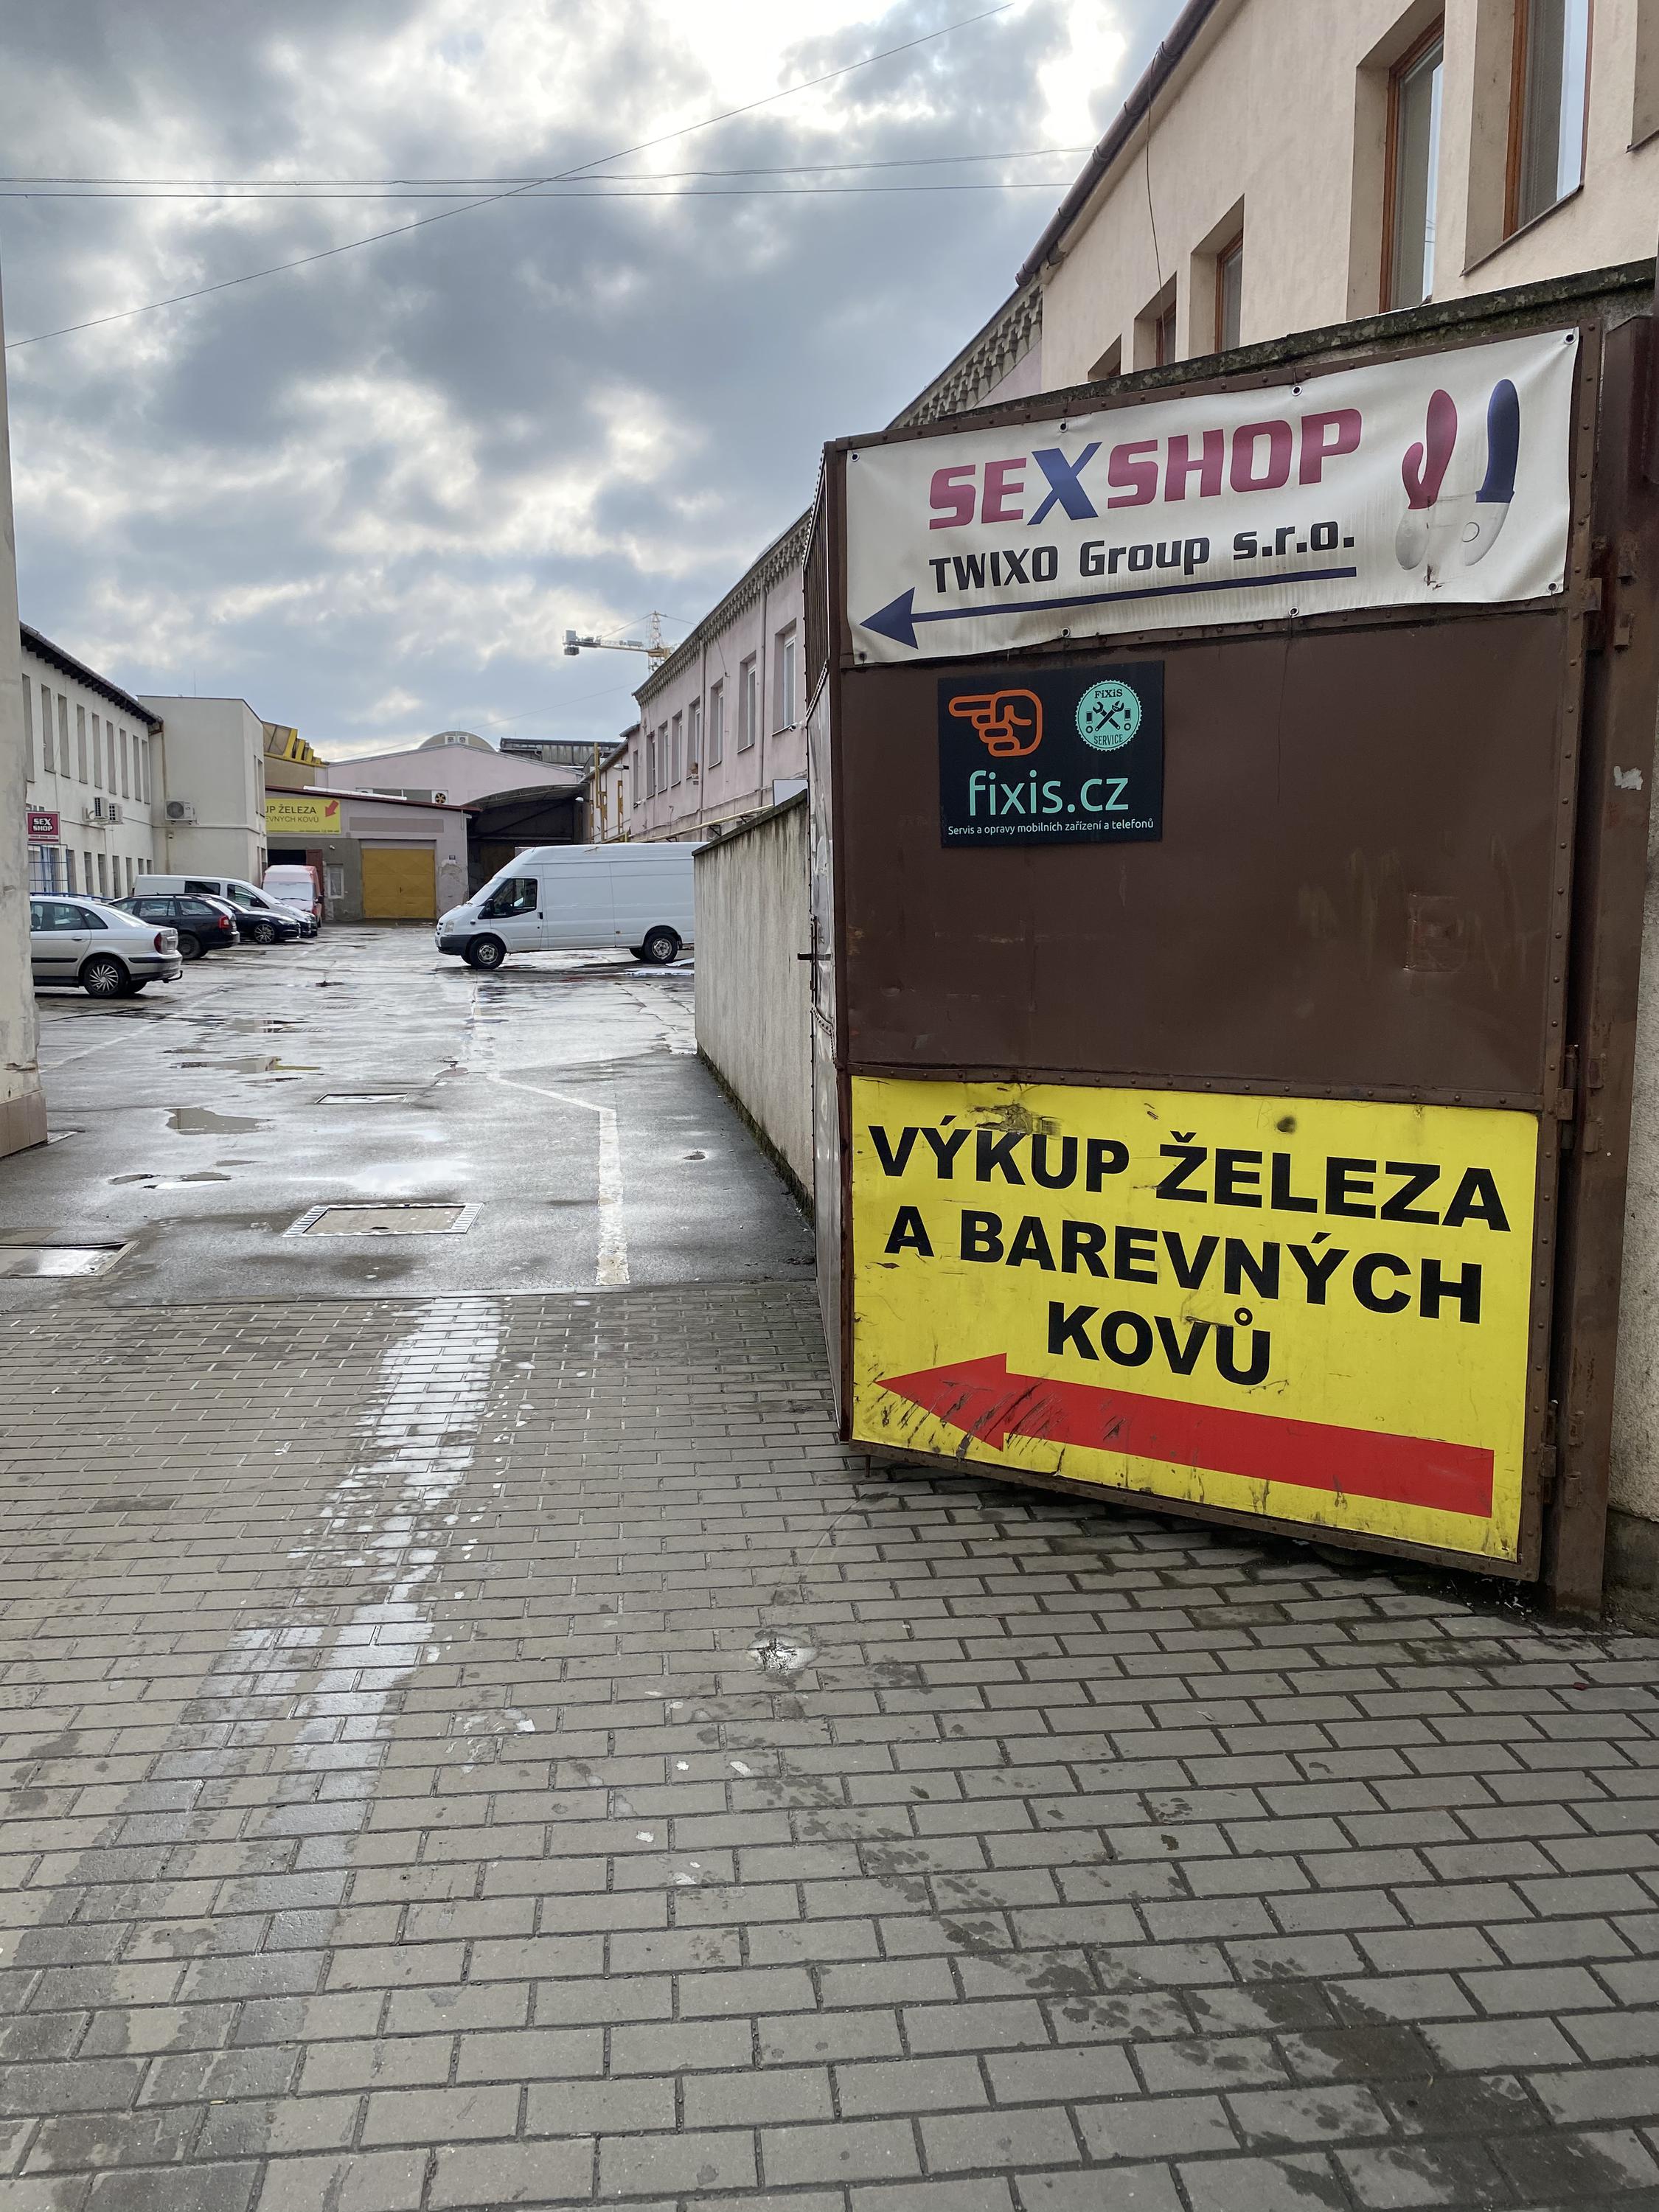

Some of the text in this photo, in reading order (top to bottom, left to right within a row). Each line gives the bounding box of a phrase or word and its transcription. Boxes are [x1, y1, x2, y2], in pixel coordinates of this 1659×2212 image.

[928, 408, 1363, 530] SEXSHOP
[928, 521, 1355, 594] TWIXO Group s.r.o.
[1093, 734, 1124, 745] SERVICE
[279, 804, 316, 814] ŽELEZA
[948, 825, 975, 835] Servis
[984, 825, 1015, 835] opravy
[1018, 821, 1062, 832] mobilních
[1065, 820, 1102, 831] zařízení
[1112, 818, 1154, 830] telefonů
[969, 770, 1129, 816] fixis.cz
[869, 1115, 1512, 1233] VÝKUP ŽELEZA
[885, 1206, 1483, 1324] A BAREVNÝCH
[1047, 1301, 1271, 1386] KOVŮ
